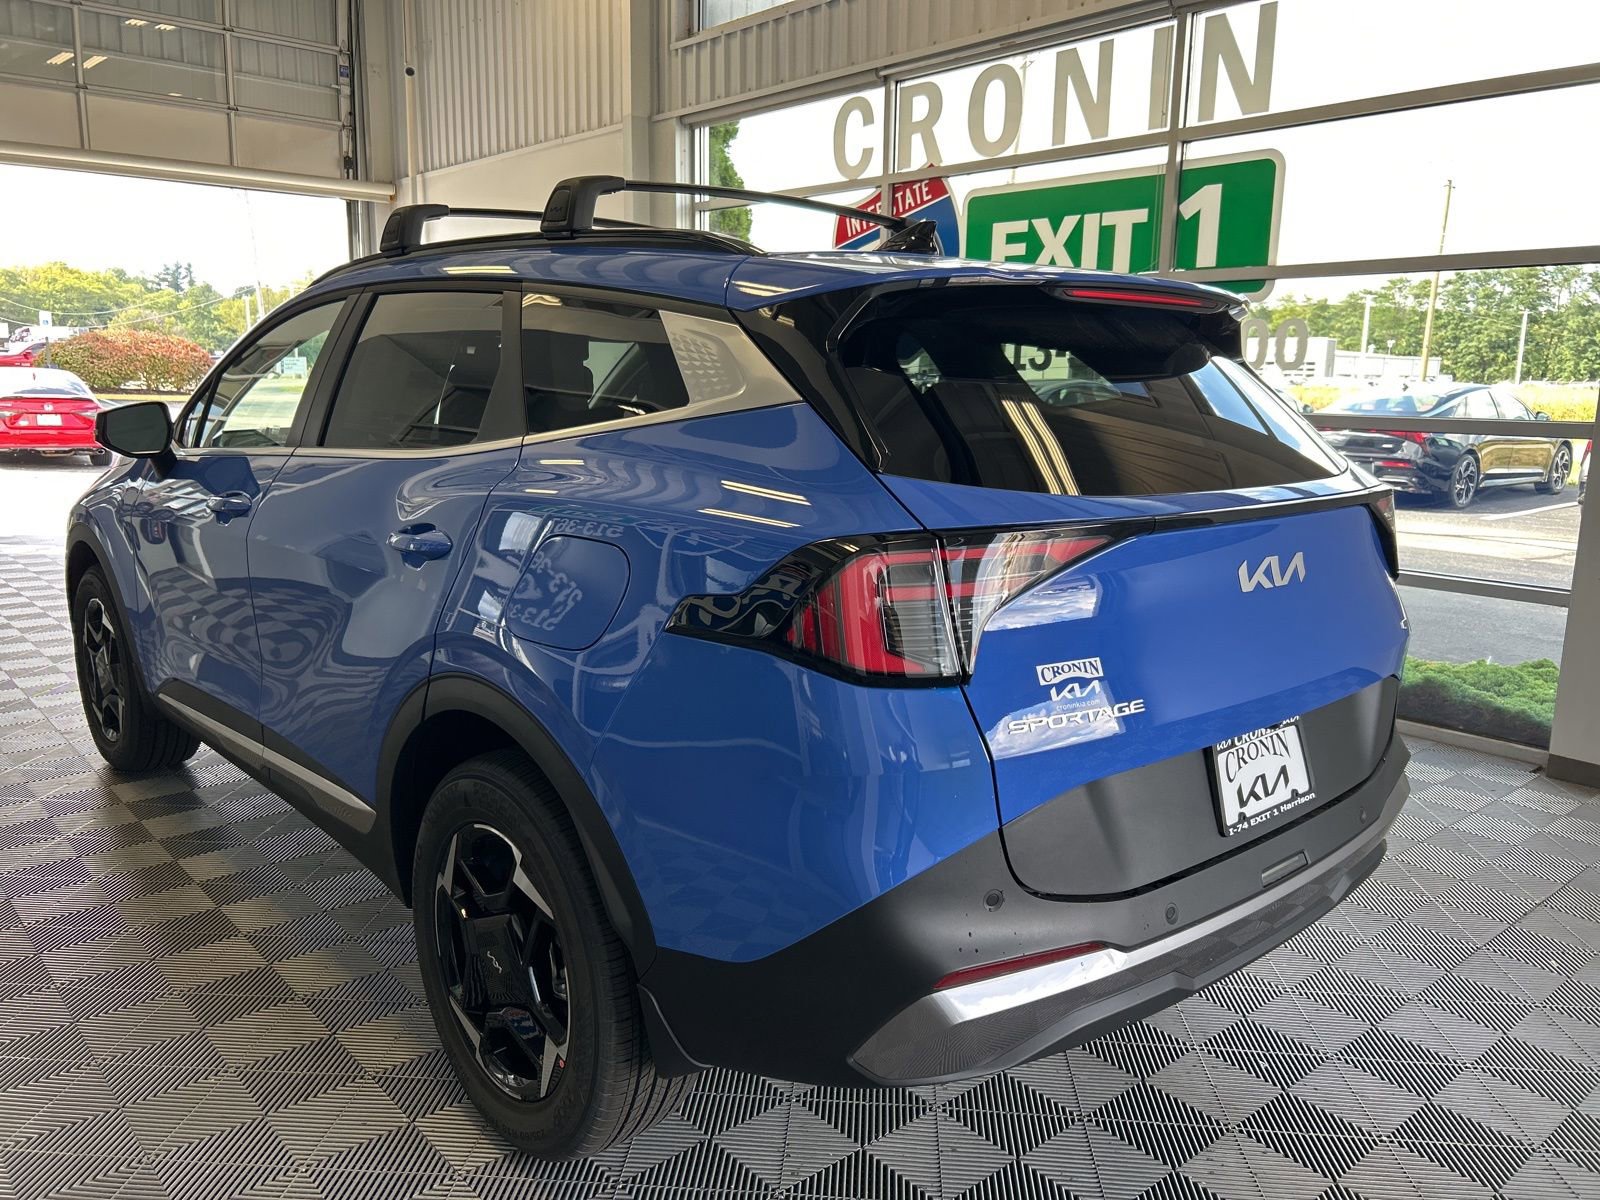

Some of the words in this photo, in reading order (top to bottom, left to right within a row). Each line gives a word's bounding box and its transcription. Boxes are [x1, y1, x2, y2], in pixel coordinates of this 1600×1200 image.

[833, 1, 1278, 180] CRONIN
[991, 208, 1149, 275] EXIT
[1178, 183, 1223, 268] 1
[1238, 551, 1306, 593] KIA
[1040, 659, 1100, 683] CRONIN
[1050, 680, 1101, 701] KIA
[1008, 699, 1146, 735] SPORTAGE
[1056, 700, 1101, 712] croninkia.com
[1225, 729, 1291, 783] CRONIN
[1236, 764, 1290, 809] KIA
[1228, 821, 1249, 836] I-74
[1250, 811, 1271, 826] EXIT
[1272, 808, 1280, 817] 1
[1280, 791, 1316, 813] Harrison
